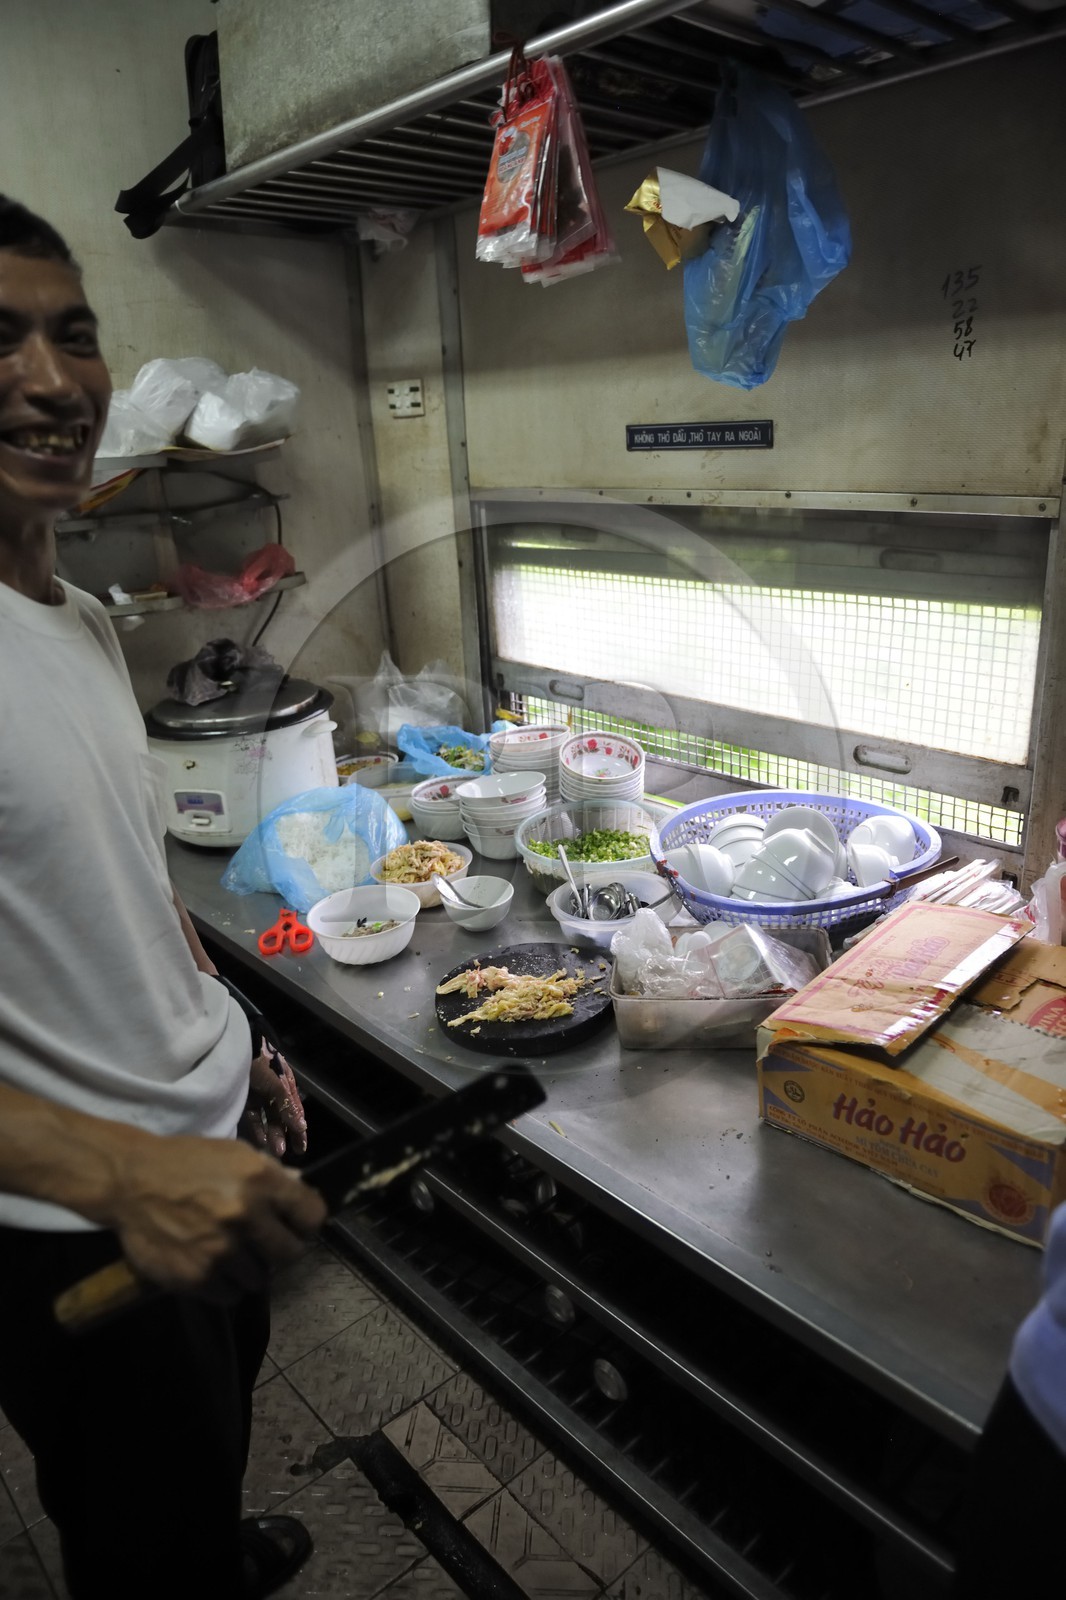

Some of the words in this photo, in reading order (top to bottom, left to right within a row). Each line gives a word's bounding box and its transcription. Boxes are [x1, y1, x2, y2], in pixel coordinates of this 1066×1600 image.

[942, 264, 983, 299] 135
[953, 316, 974, 340] 58
[953, 339, 977, 361] 47
[634, 430, 655, 444] KHÔNG
[706, 431, 722, 442] TAY
[724, 431, 736, 442] RA
[738, 427, 762, 441] NGOÀI
[833, 1092, 894, 1136] Hảo
[899, 1117, 967, 1163] Hảo
